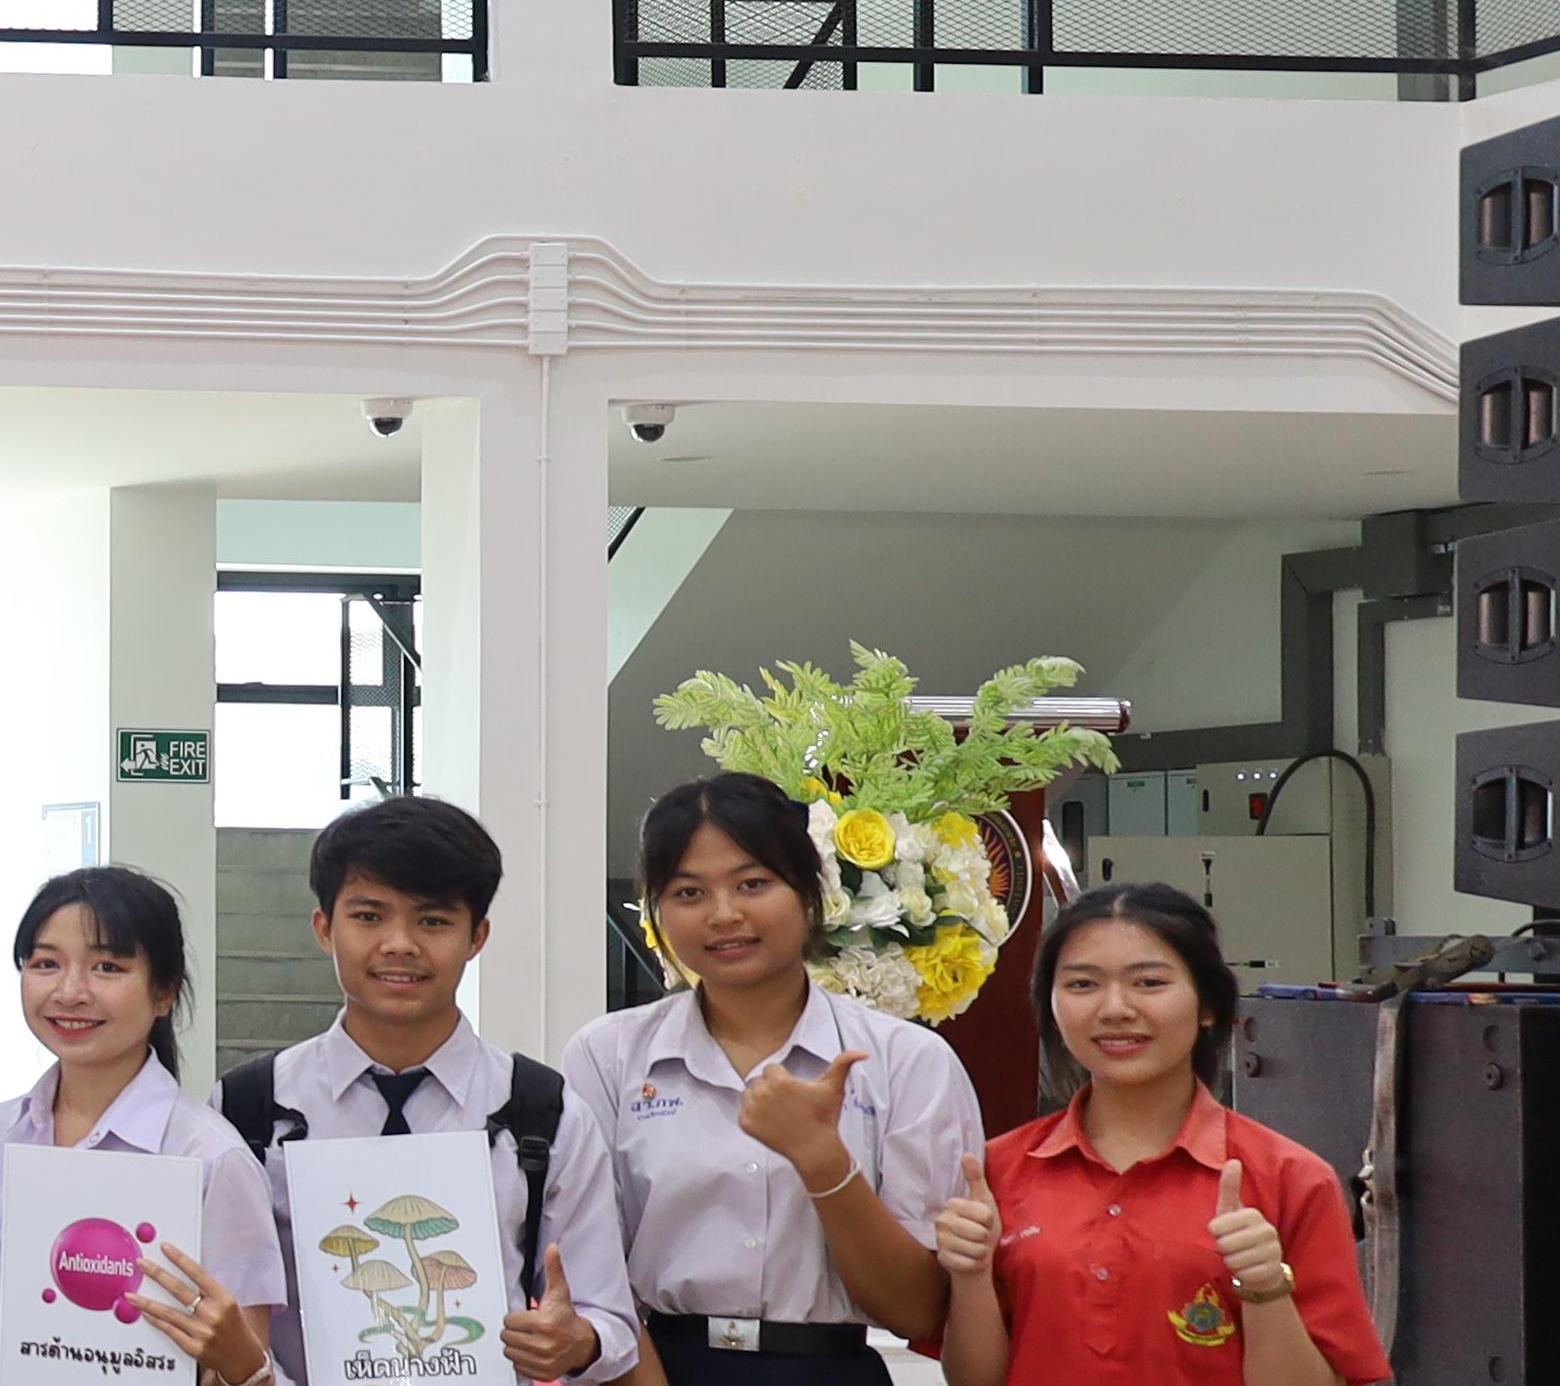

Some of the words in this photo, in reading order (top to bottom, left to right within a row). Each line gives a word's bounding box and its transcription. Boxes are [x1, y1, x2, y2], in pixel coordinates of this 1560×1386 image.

[169, 741, 206, 758] FIRE
[169, 759, 206, 775] EXIT
[59, 1251, 134, 1277] Antioxidants
[20, 1337, 175, 1376] สารต้านอนุมูลอิสระ
[344, 1348, 478, 1381] เห็ดนางฟ้า
